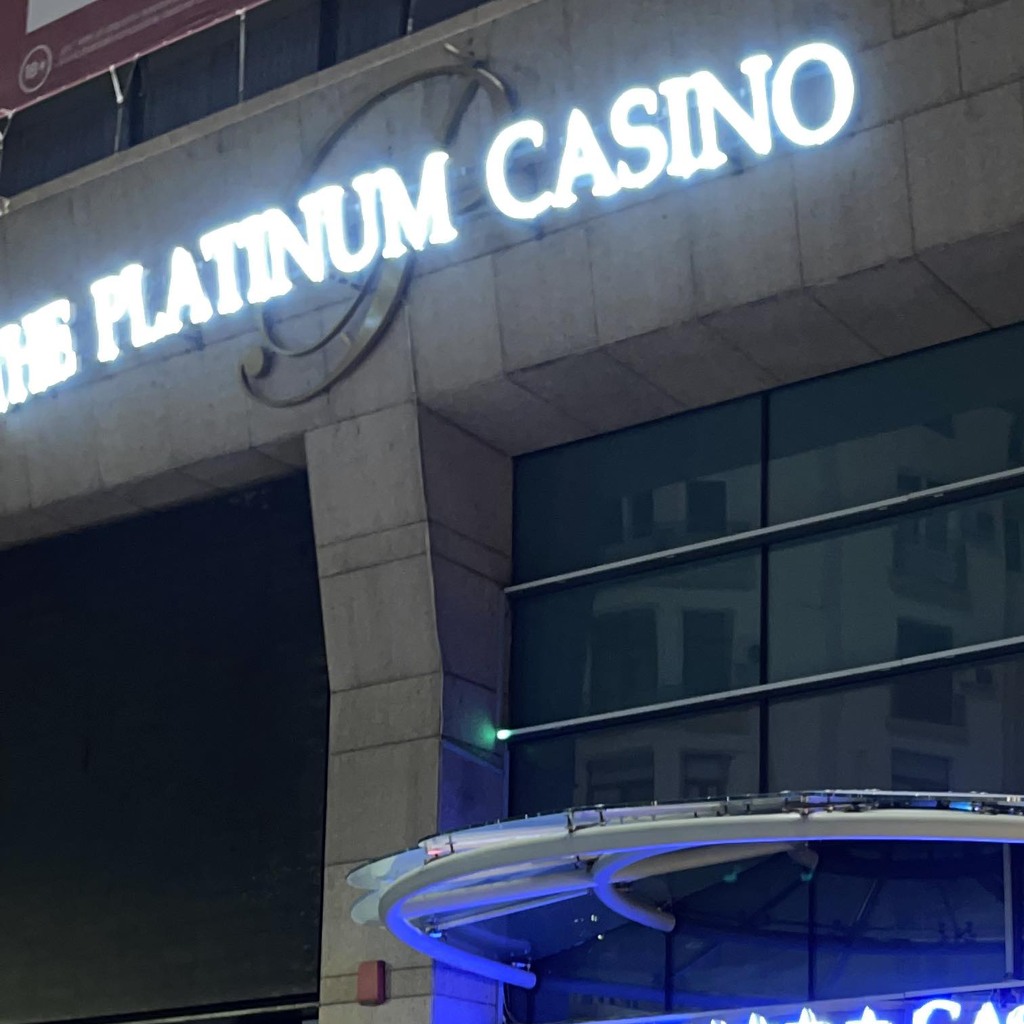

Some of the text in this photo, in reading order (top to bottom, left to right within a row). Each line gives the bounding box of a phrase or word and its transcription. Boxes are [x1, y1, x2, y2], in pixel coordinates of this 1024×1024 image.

[0, 41, 856, 414] HE PLATINUM CASINO
